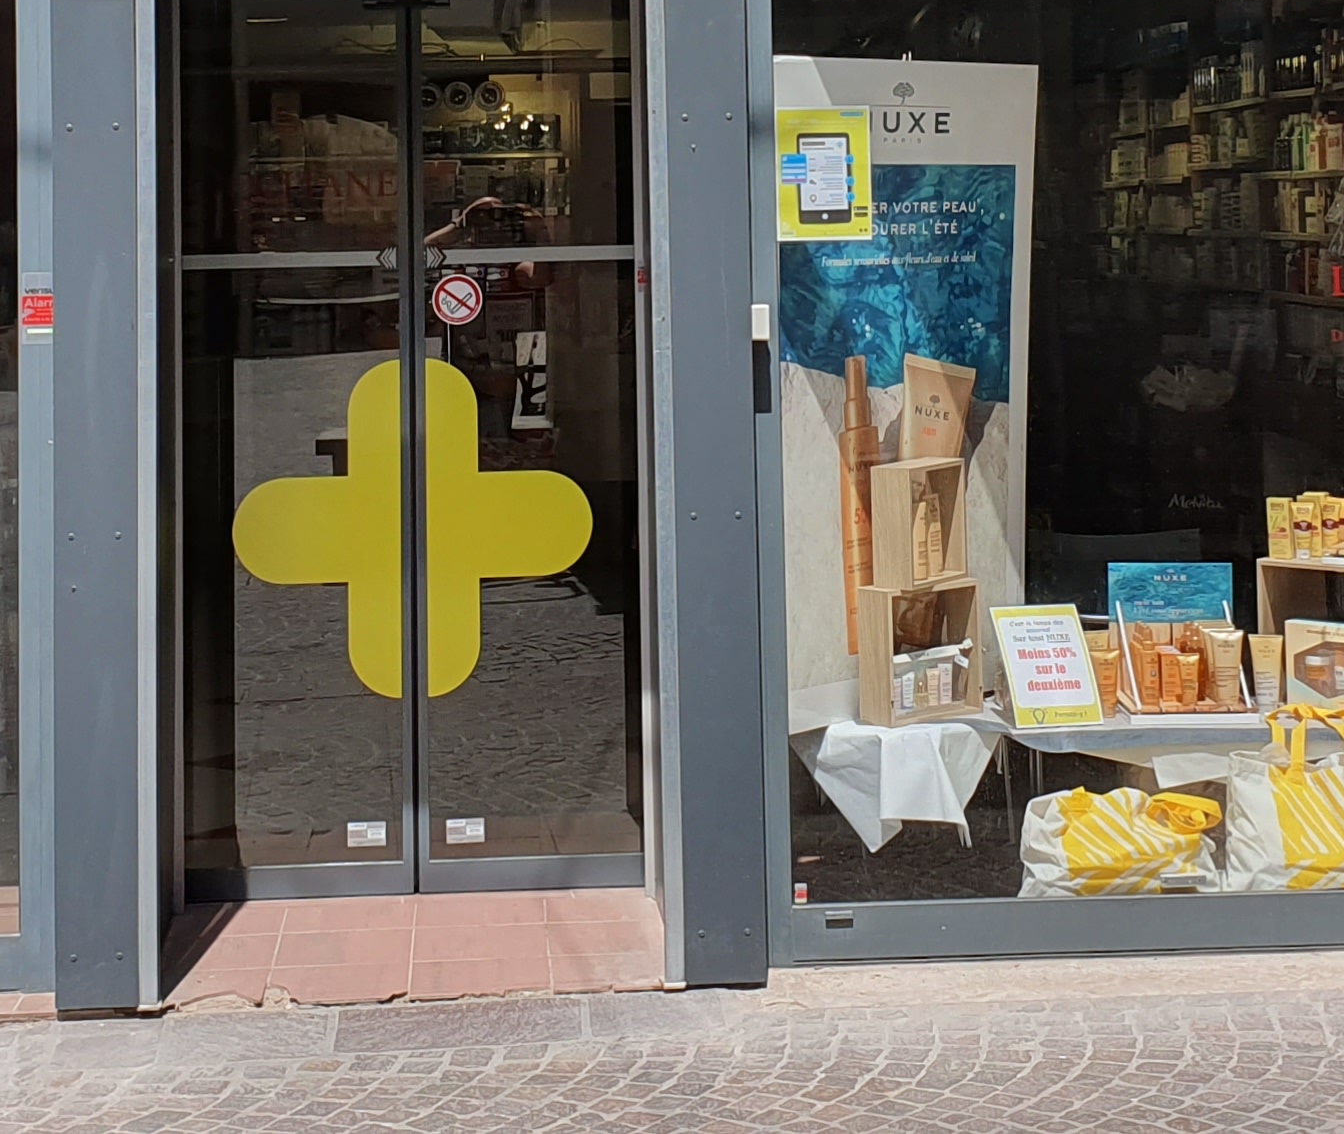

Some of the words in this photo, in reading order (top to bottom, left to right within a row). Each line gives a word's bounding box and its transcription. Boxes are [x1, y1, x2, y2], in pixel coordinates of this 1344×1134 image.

[892, 201, 937, 214] VOTRE
[914, 404, 950, 422] NUXE
[1153, 574, 1188, 582] NUXE
[1017, 648, 1051, 660] Moins
[1053, 647, 1077, 659] 50%
[1035, 665, 1053, 676] sur
[1055, 662, 1067, 674] le
[1027, 678, 1081, 692] deuxième
